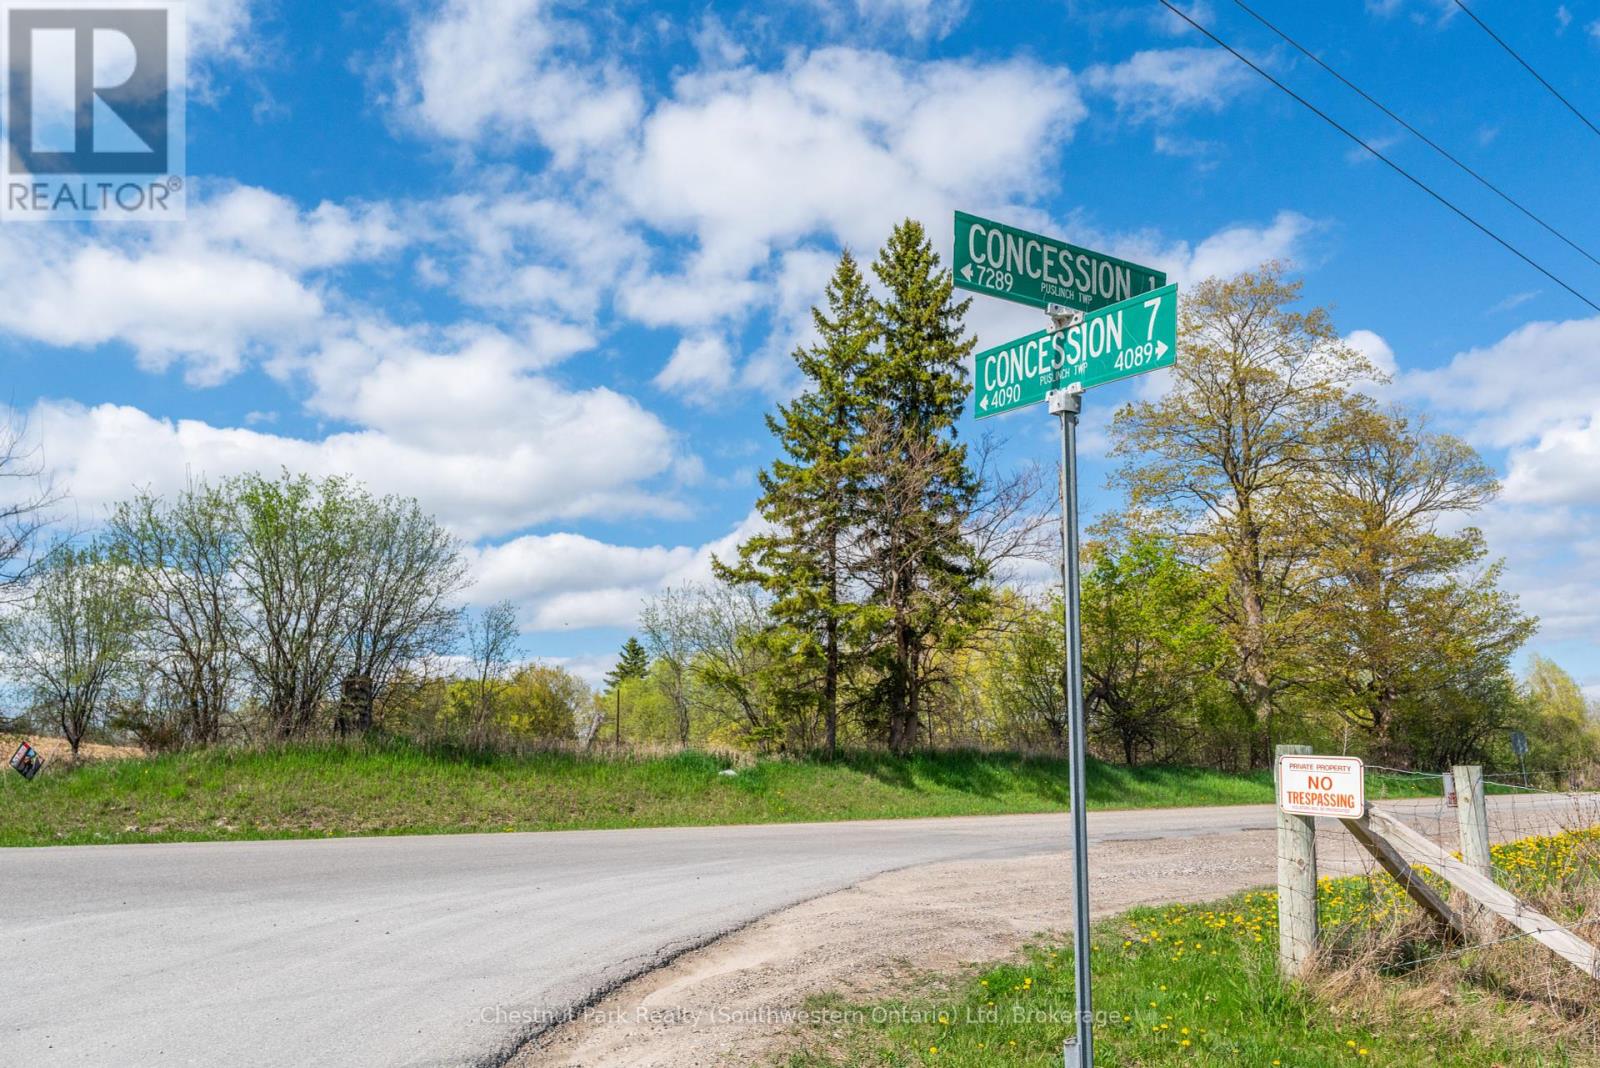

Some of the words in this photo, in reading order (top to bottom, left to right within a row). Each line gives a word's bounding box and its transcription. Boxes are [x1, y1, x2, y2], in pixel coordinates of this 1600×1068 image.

[969, 224, 1130, 301] CONCESSION
[977, 265, 1013, 292] 7289
[1041, 282, 1075, 299] PUSLINCH
[1078, 292, 1093, 304] TWP
[985, 310, 1123, 391] CONCESSION
[1144, 297, 1161, 341] 7
[1114, 343, 1153, 371] 4089
[1039, 367, 1070, 386] PUSLINCH
[1074, 361, 1088, 376] TWP
[991, 385, 1021, 409] 4090
[1316, 764, 1351, 772] PROPERTY
[1308, 775, 1333, 791] NO
[1287, 791, 1355, 809] TRESPASSING
